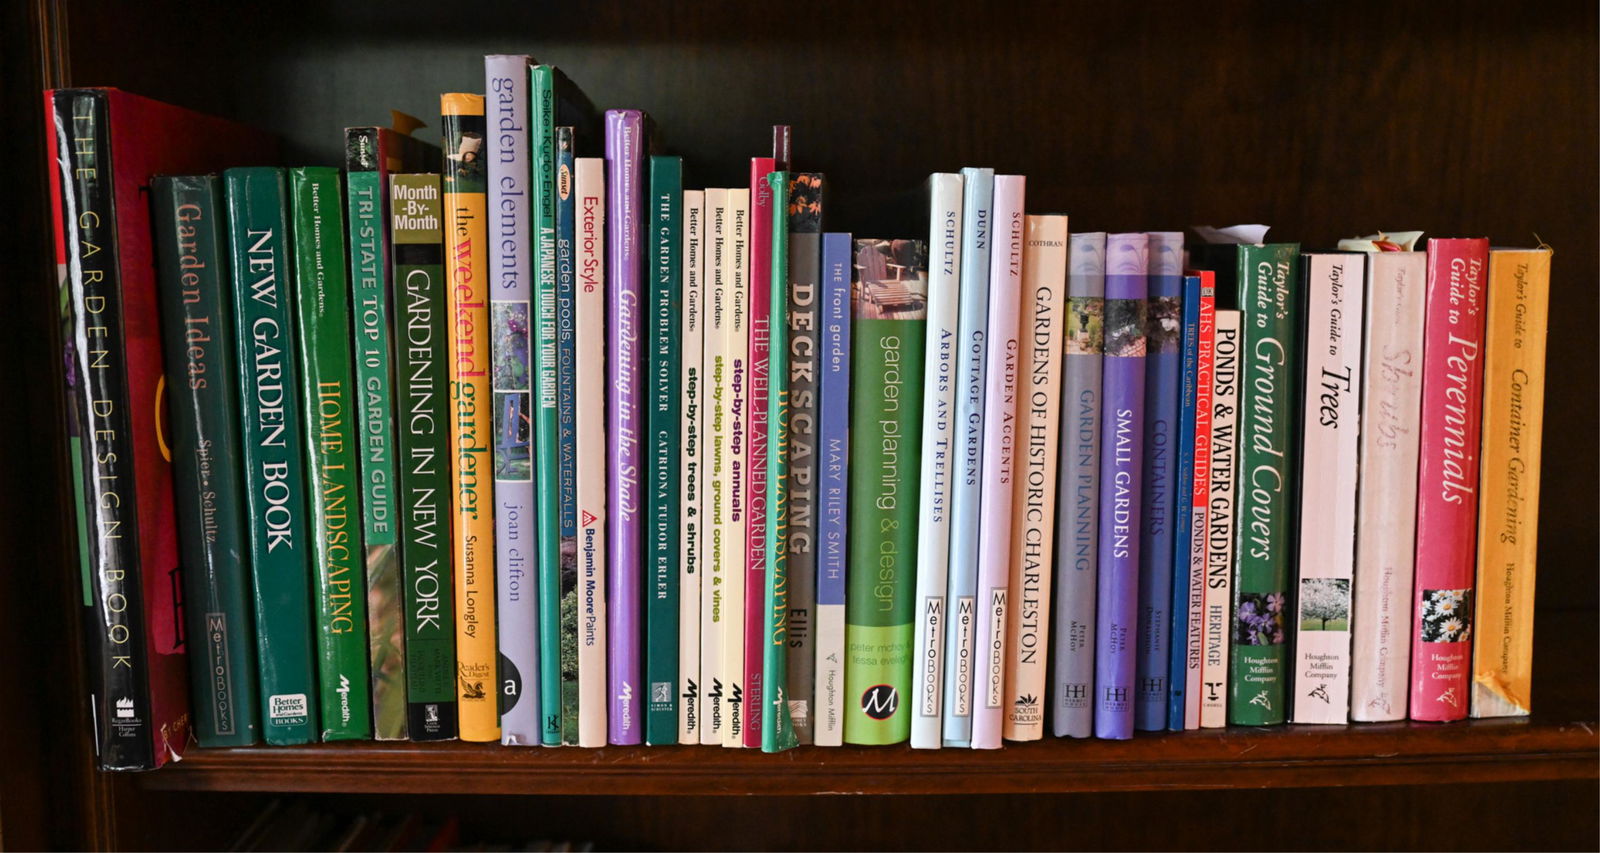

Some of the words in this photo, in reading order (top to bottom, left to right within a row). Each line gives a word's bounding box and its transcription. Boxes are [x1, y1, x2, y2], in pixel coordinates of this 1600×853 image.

[492, 78, 522, 164] garden
[542, 89, 552, 126] Seike
[73, 110, 96, 181] THE
[312, 183, 321, 213] Better
[393, 184, 437, 200] Month
[542, 181, 553, 218] Engel
[660, 194, 670, 219] THE
[314, 216, 322, 249] Homes
[358, 186, 376, 289] TRI-STATE
[394, 215, 438, 230] Month
[455, 207, 474, 237] the
[498, 177, 523, 290] elements
[584, 196, 598, 256] Exterior
[688, 208, 698, 236] Better
[714, 207, 723, 234] Better
[735, 210, 744, 236] Better
[943, 211, 956, 276] SCHULTZ
[976, 210, 986, 250] DUNN
[1010, 212, 1020, 277] SCHULTZ
[176, 204, 206, 304] Garden
[247, 227, 277, 308] NEW
[541, 235, 554, 285] JAPANESE
[558, 240, 572, 293] garden
[580, 260, 598, 292] Style
[660, 228, 670, 282] GARDEN
[688, 238, 698, 270] Homes
[714, 238, 723, 266] Homes
[735, 240, 744, 270] Homes
[833, 263, 842, 282] THE
[79, 211, 110, 369] GARDEN
[452, 237, 486, 377] weekend
[541, 288, 554, 319] TOUCH
[833, 288, 845, 319] front
[1256, 262, 1272, 308] Guide
[1273, 262, 1289, 319] Taylor's
[1329, 264, 1343, 305] Taylor's
[1450, 258, 1466, 305] Guide
[1465, 259, 1482, 316] Taylor's
[1515, 264, 1528, 299] Taylor's
[362, 295, 378, 340] TOP
[541, 322, 554, 340] FOR
[560, 299, 573, 343] pools,
[616, 289, 637, 394] Gardening
[660, 290, 669, 354] PROBLEM
[754, 315, 769, 352] THE
[1032, 287, 1052, 385] GARDENS
[1186, 324, 1195, 347] TREES
[1200, 301, 1212, 333] AHS
[1330, 308, 1341, 342] Guide
[1515, 304, 1526, 336] Guide
[184, 316, 210, 390] Ideas
[365, 348, 380, 368] 10
[406, 269, 435, 436] GARDENING
[541, 342, 555, 368] YOUR
[830, 325, 843, 372] garden
[880, 335, 903, 412] garden
[1215, 329, 1236, 395] PONDS
[252, 317, 286, 447] GARDEN
[542, 370, 556, 408] GARDEN
[561, 348, 571, 424] FOUNTAINS
[659, 361, 669, 412] SOLVER
[712, 355, 723, 432] step-by-step
[731, 359, 742, 455] step-by-step
[1031, 391, 1048, 419] OF
[1185, 370, 1193, 407] Caribbean
[1196, 339, 1211, 428] PRACTICAL
[1252, 337, 1285, 458] Ground
[1319, 367, 1351, 428] Trees
[316, 380, 343, 454] HOME
[366, 377, 384, 464] GARDEN
[619, 400, 635, 419] in
[686, 367, 697, 457] step-by-step
[752, 360, 769, 493] WELL-PLANNED
[789, 282, 813, 555] DECKSCAPING
[1078, 390, 1095, 467] GARDEN
[1214, 404, 1233, 420] &
[1441, 331, 1478, 505] Perennials
[1507, 368, 1528, 454] Container
[196, 440, 213, 476] Spier
[412, 447, 435, 474] IN
[450, 380, 487, 520] gardener
[620, 428, 636, 456] the
[712, 436, 722, 476] lawns,
[830, 440, 841, 480] MARY
[1116, 409, 1131, 466] SMALL
[1212, 424, 1232, 493] WATER
[92, 400, 122, 539] DESIGN
[563, 443, 572, 528] WATERFALLS
[658, 431, 668, 498] CATRIONA
[687, 462, 696, 501] trees
[876, 420, 902, 510] planning
[1026, 424, 1046, 522] HISTORIC
[1149, 420, 1167, 535] CONTAINERS
[1194, 435, 1208, 495] GUIDES
[202, 492, 218, 542] Schultz
[262, 461, 292, 553] BOOK
[372, 469, 388, 533] GUIDE
[619, 463, 637, 521] Shade
[712, 481, 722, 525] ground
[732, 461, 742, 522] annuals
[828, 488, 840, 525] RILEY
[1114, 472, 1131, 558] GARDENS
[1250, 465, 1281, 561] Covers
[1500, 457, 1525, 545] Gardening
[413, 488, 437, 549] NEW
[503, 502, 524, 540] joan
[658, 504, 667, 552] TUDOR
[751, 497, 766, 570] GARDEN
[1076, 475, 1092, 571] PLANNING
[1192, 512, 1204, 553] PONDS
[1209, 498, 1230, 589] GARDENS
[322, 464, 353, 634] LANDSCAPING
[465, 535, 478, 587] Susanna
[584, 528, 596, 577] Benjamin
[686, 523, 696, 574] shrubs
[828, 532, 840, 579] SMITH
[415, 559, 440, 633] YORK
[508, 549, 524, 602] clifton
[658, 557, 667, 599] ERLER
[874, 540, 899, 612] design
[1022, 528, 1042, 664] CHARLESTON
[1191, 568, 1202, 608] WATER
[1382, 567, 1392, 611] Houghton
[1502, 563, 1515, 603] Houghton
[105, 569, 131, 669] BOOK
[464, 590, 479, 638] Longley
[712, 590, 721, 622] vines
[790, 609, 807, 648] Ellis
[1503, 606, 1513, 634] Mifflin
[1189, 611, 1200, 669] FEATURES
[1208, 605, 1222, 666] HERITAGE
[1500, 637, 1511, 674] Company
[273, 704, 304, 713] Homes
[275, 698, 302, 706] Better
[618, 682, 632, 730] Meredith
[683, 678, 697, 729] Meredith
[708, 678, 722, 729] Meredith
[728, 683, 742, 735] Meredith
[749, 673, 761, 730] STERLING
[826, 670, 836, 705] Houghton
[827, 708, 835, 731] Mifflin
